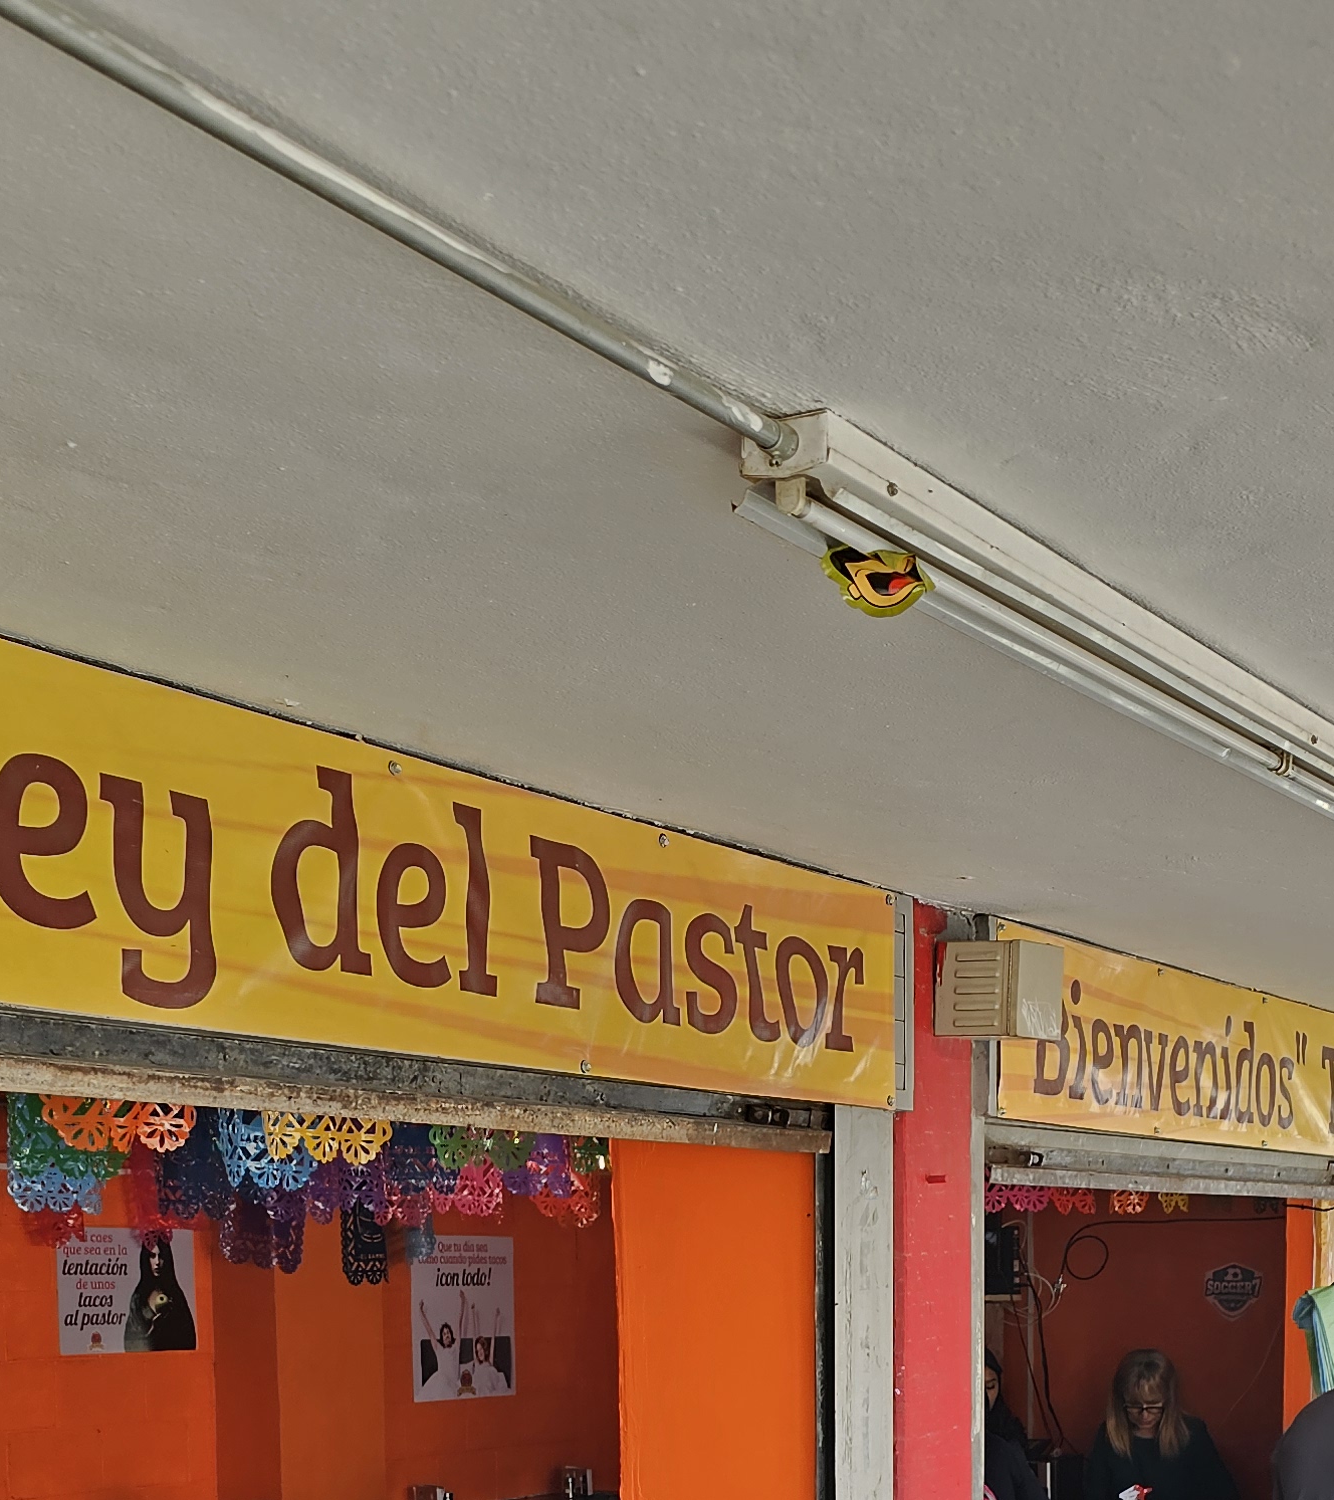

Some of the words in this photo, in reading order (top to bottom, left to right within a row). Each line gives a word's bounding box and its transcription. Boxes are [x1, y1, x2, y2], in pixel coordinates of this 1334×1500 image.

[269, 766, 498, 997] del
[528, 833, 865, 1053] Pastor
[90, 1234, 114, 1243] caes
[62, 1246, 82, 1258] que
[84, 1246, 101, 1256] sea
[103, 1246, 116, 1256] en
[118, 1244, 128, 1256] la
[61, 1257, 128, 1276] tentación
[75, 1278, 88, 1290] de
[90, 1280, 116, 1290] unos
[461, 1267, 492, 1287] todo!
[77, 1292, 114, 1308] tacos
[63, 1309, 79, 1327] al
[79, 1309, 126, 1332] pastor
